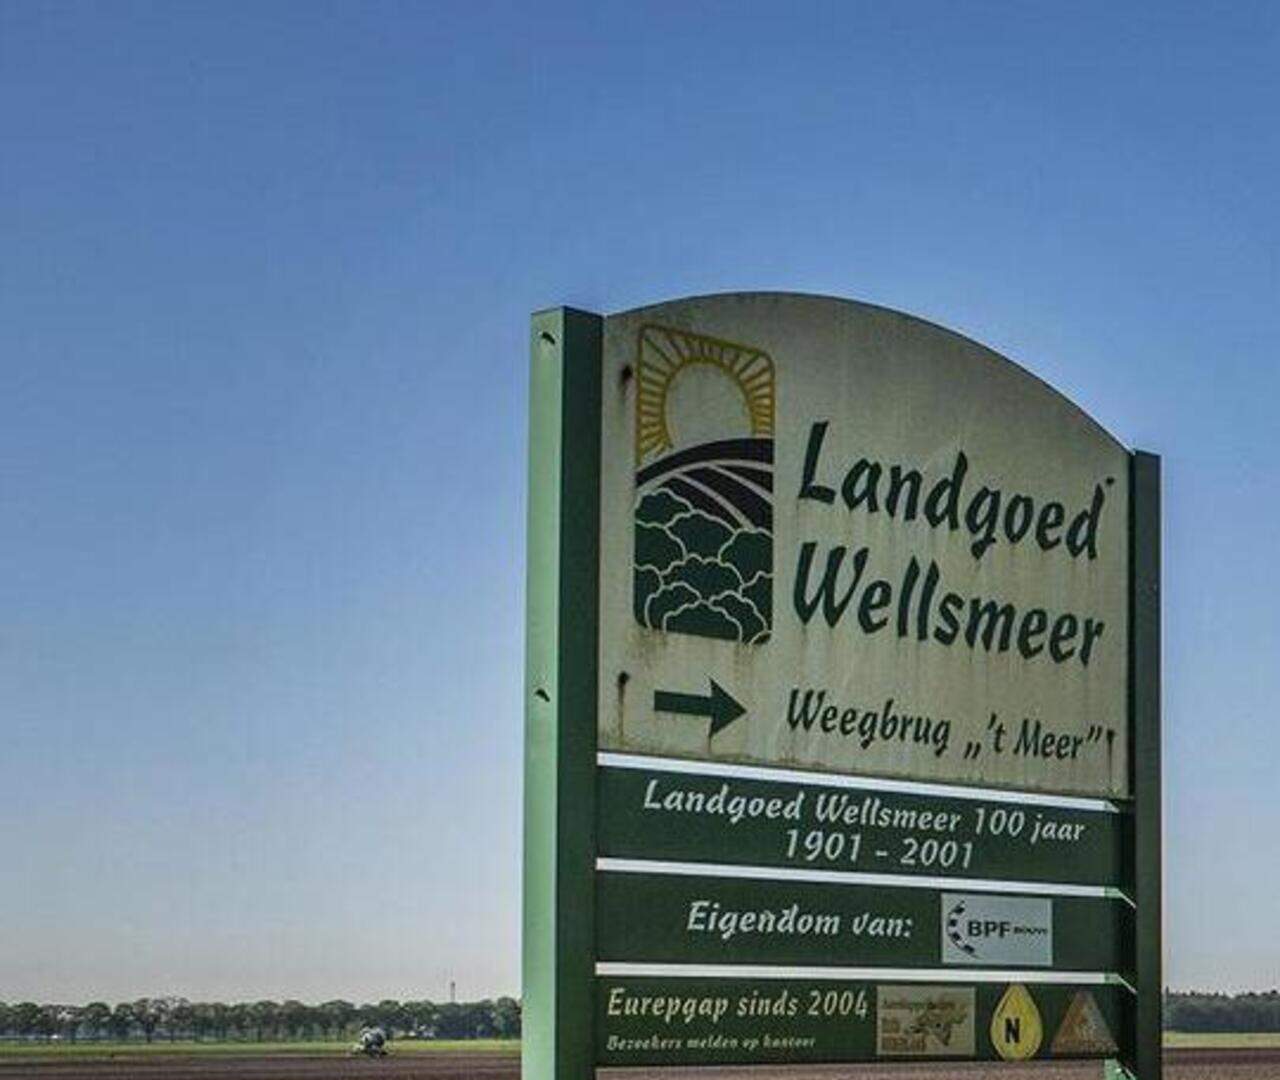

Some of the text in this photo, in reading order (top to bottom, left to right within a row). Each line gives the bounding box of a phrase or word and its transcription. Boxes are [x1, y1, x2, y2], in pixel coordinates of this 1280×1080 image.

[797, 421, 1104, 561] Landgoed
[792, 542, 1105, 667] Wellsmeer
[786, 689, 951, 756] Weegbrug
[643, 780, 1086, 844] Landgoed Wellsmeer 100 jaar
[785, 830, 864, 862] 1901
[900, 839, 975, 869] 2001
[686, 901, 913, 939] Eigendom van:
[967, 920, 1011, 939] BPF
[607, 987, 728, 1023] Eurepgap
[736, 990, 799, 1016] sinds
[807, 990, 869, 1018] 2004
[1004, 1017, 1021, 1044] N
